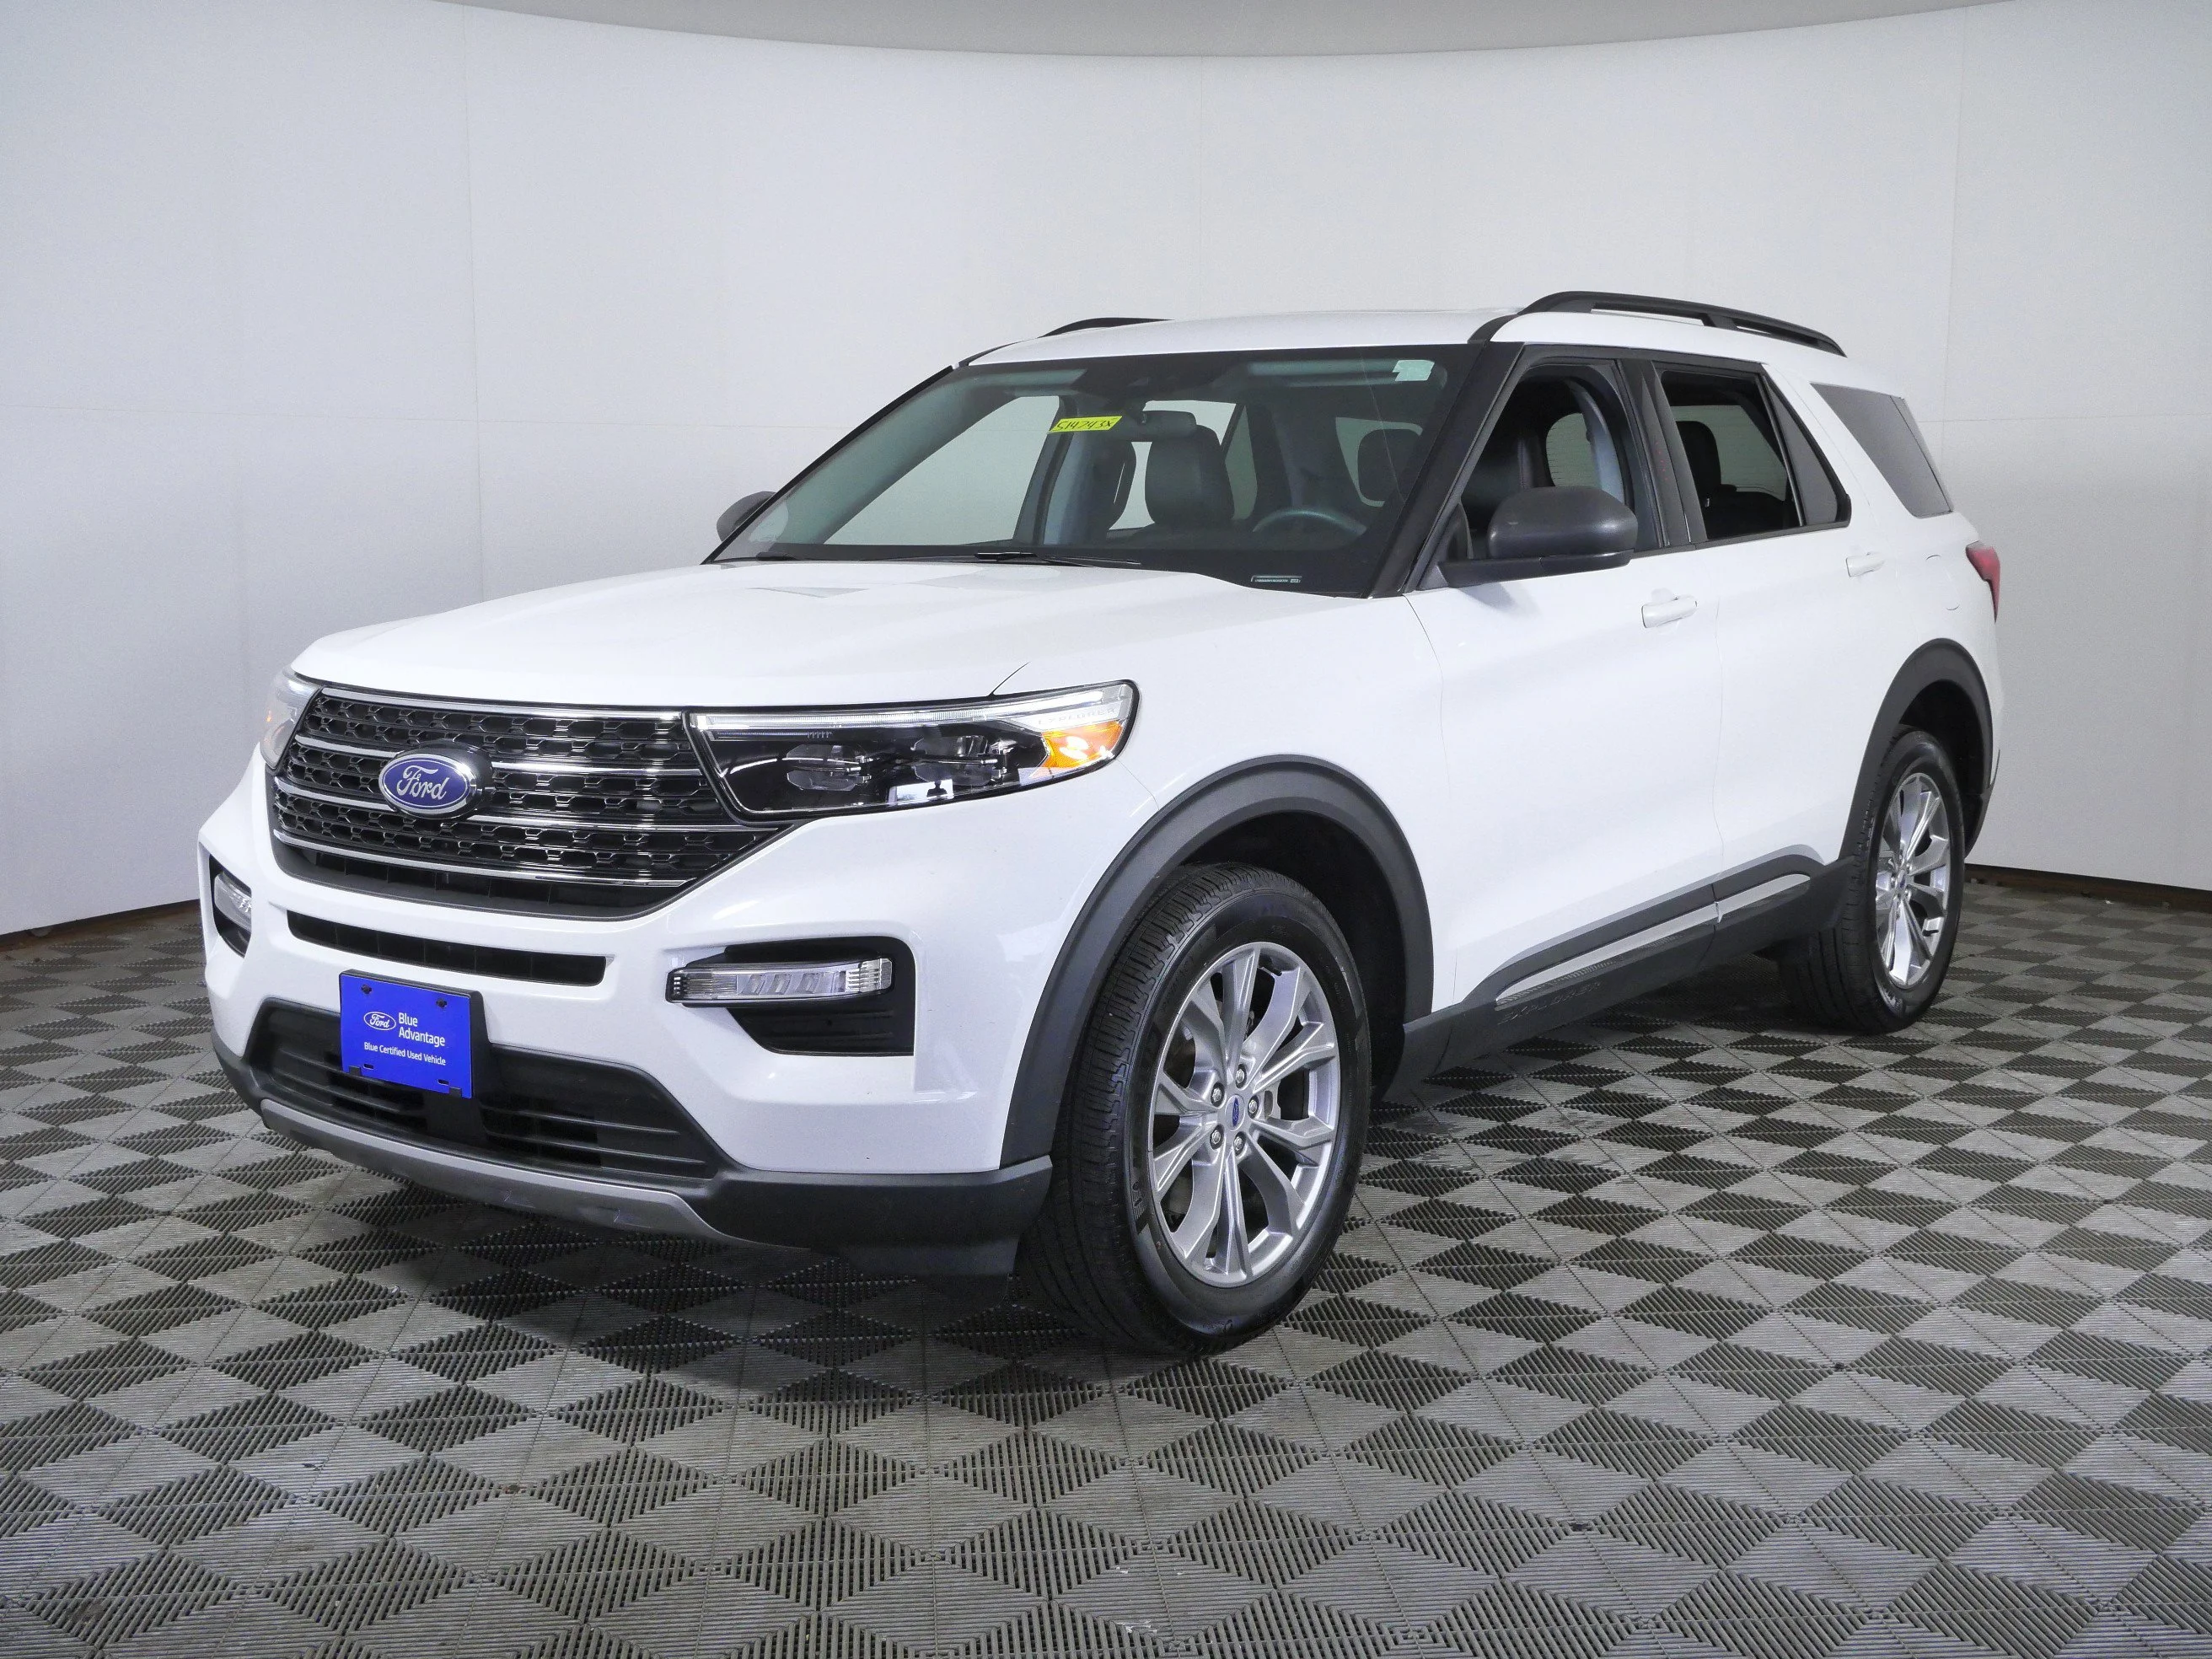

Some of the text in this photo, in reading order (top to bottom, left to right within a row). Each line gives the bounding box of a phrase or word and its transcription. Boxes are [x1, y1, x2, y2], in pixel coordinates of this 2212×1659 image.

[396, 765, 450, 800] Ford
[369, 1013, 390, 1028] Ford
[398, 1012, 418, 1027] Blue
[399, 1027, 445, 1048] Advantage
[364, 1041, 446, 1066] Blue Certified Used Vehicle
